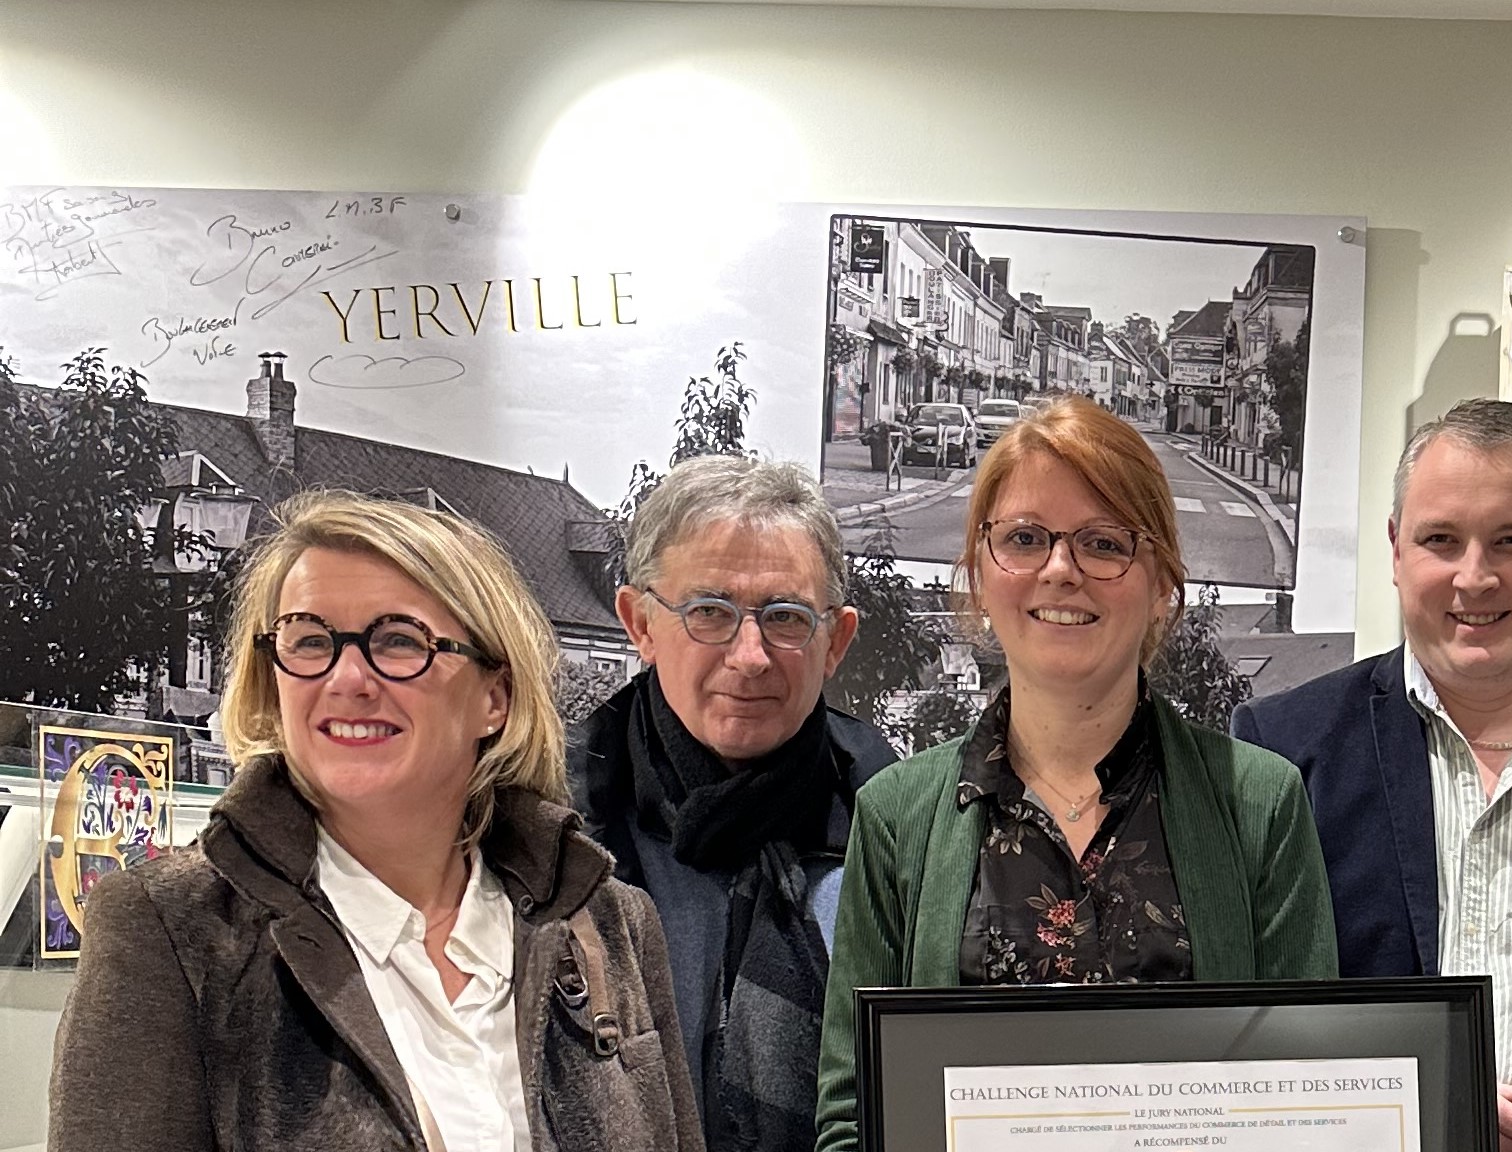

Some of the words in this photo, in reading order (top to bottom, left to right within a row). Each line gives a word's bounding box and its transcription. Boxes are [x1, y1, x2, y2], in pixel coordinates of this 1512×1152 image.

[320, 271, 637, 344] YERVILLE
[949, 1086, 1049, 1101] CHALLENGE
[1054, 1084, 1143, 1099] NATIONAL
[1148, 1083, 1173, 1097] DU
[1178, 1081, 1273, 1096] COMMERCE
[1278, 1080, 1296, 1093] ET
[1302, 1079, 1330, 1092] DES
[1334, 1077, 1404, 1091] SERVICES
[1134, 1109, 1146, 1118] LE
[1148, 1109, 1172, 1119] JURY
[1173, 1107, 1225, 1118] NATIONAL
[1114, 1124, 1127, 1132] LES
[1128, 1121, 1188, 1131] PERFORMANCES
[1201, 1121, 1245, 1129] COMMERCE
[1247, 1120, 1258, 1128] DE
[1287, 1119, 1297, 1127] ET
[1298, 1118, 1312, 1126] DES
[1313, 1117, 1347, 1127] SERVICES
[1133, 1139, 1141, 1147] A
[1143, 1135, 1209, 1147] RÉCOMPENSÉ
[1211, 1136, 1228, 1146] DU
